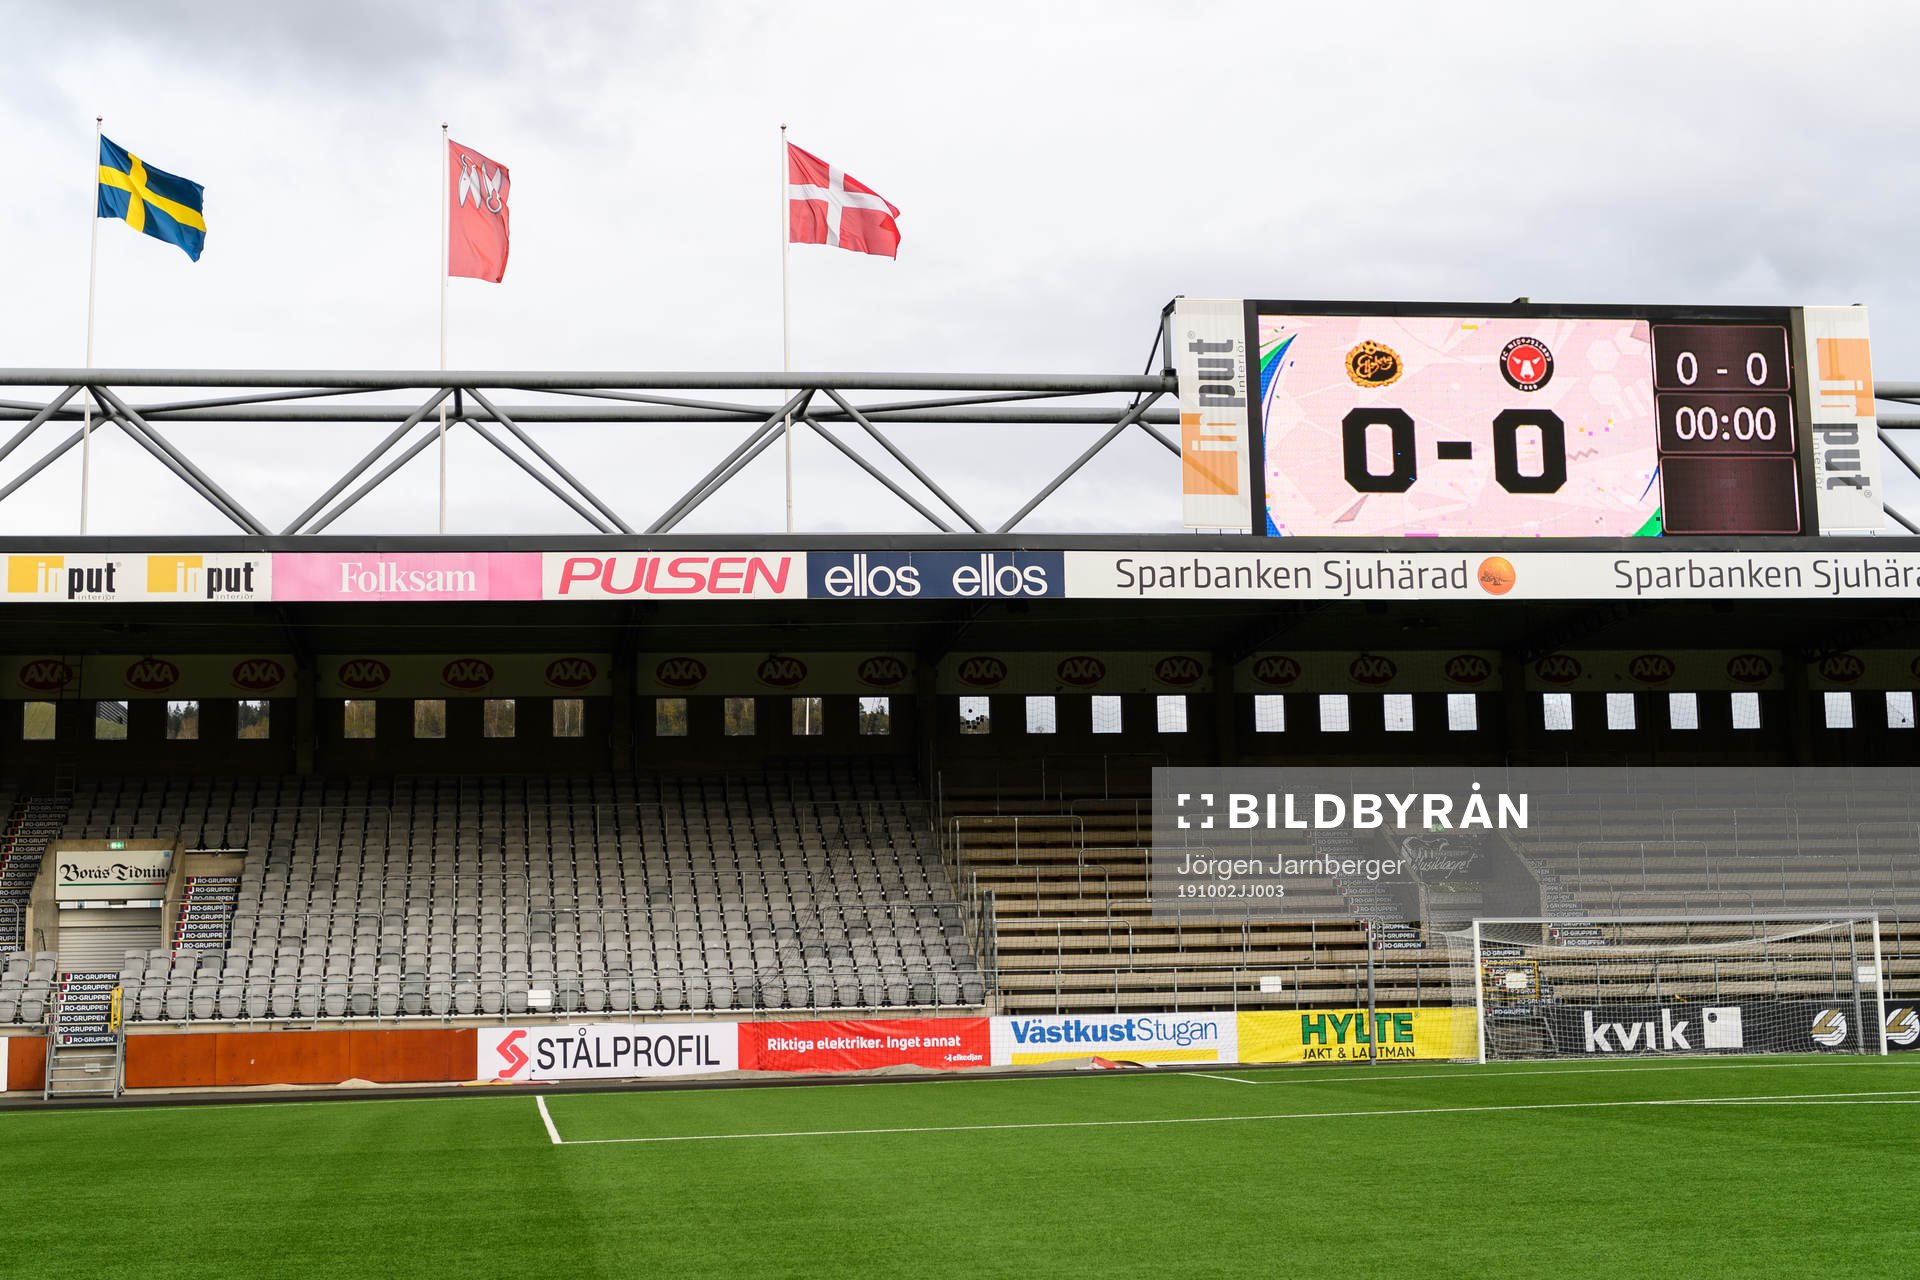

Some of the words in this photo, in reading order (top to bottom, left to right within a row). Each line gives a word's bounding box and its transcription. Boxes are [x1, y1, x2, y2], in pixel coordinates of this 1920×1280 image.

[1676, 351, 1698, 385] 0
[1747, 352, 1768, 385] 0
[1675, 406, 1777, 441] 00:00
[338, 561, 477, 594] Folksam
[558, 557, 792, 595] PULSEN
[825, 554, 921, 597] ellos
[952, 553, 1048, 597] ellos
[1116, 559, 1311, 595] Sparbanken
[1324, 559, 1467, 596] Sjuhärad
[1614, 559, 1801, 595] Sparbanken
[131, 664, 172, 683] AXA
[236, 663, 280, 683] AXA
[343, 662, 385, 682] AXA
[449, 662, 489, 682] AXA
[550, 661, 593, 680] AXA
[661, 660, 702, 680] AXA
[763, 660, 801, 680] AXA
[862, 660, 902, 679] AXA
[963, 659, 1002, 679] AXA
[1062, 659, 1100, 678] AXA
[1159, 659, 1200, 678] AXA
[1258, 659, 1297, 678] AXA
[1355, 659, 1393, 678] AXA
[1450, 658, 1487, 677] AXA
[1539, 657, 1577, 677] AXA
[1633, 657, 1671, 676] AXA
[1731, 657, 1768, 676] AXA
[1824, 656, 1861, 676] AXA
[59, 863, 110, 881] Borås
[1011, 1018, 1218, 1046] VästkustStugan
[1301, 1012, 1414, 1045] HYLTE
[537, 1028, 720, 1070] STÅLPROFIL
[767, 1037, 814, 1053] Riktiga
[817, 1036, 884, 1050] elektriker.
[886, 1035, 921, 1051] Inget
[923, 1035, 961, 1048] annat
[1303, 1048, 1333, 1060] JAKT
[1337, 1047, 1347, 1059] &
[1352, 1046, 1416, 1059] LATMAN
[953, 1053, 983, 1062] elkedjan
